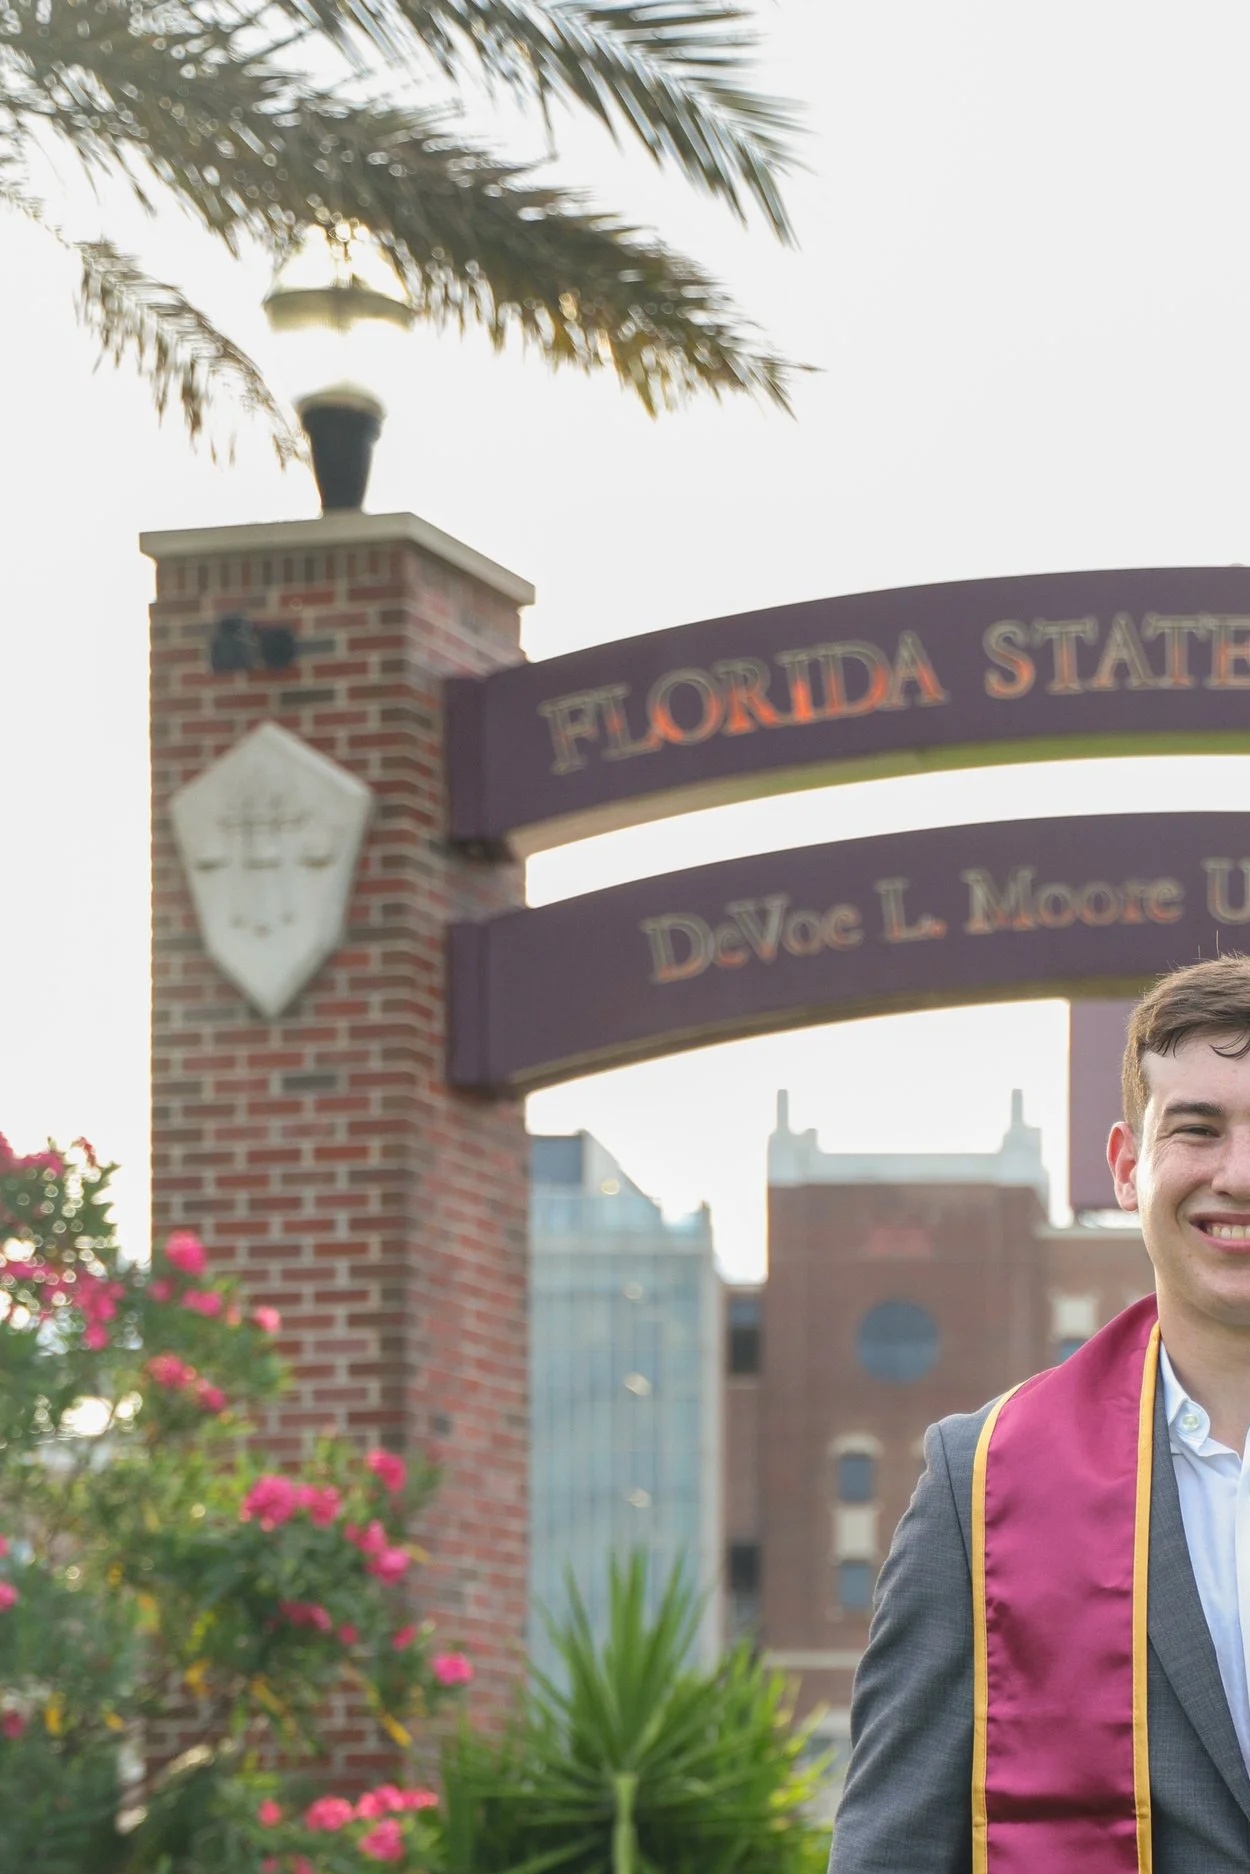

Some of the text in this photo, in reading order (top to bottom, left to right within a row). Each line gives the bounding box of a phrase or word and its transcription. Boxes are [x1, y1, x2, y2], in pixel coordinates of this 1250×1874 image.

[538, 630, 947, 776] FLORIDA
[641, 893, 864, 985] DeVoe
[875, 877, 947, 943] L.
[961, 864, 1185, 936] Moore
